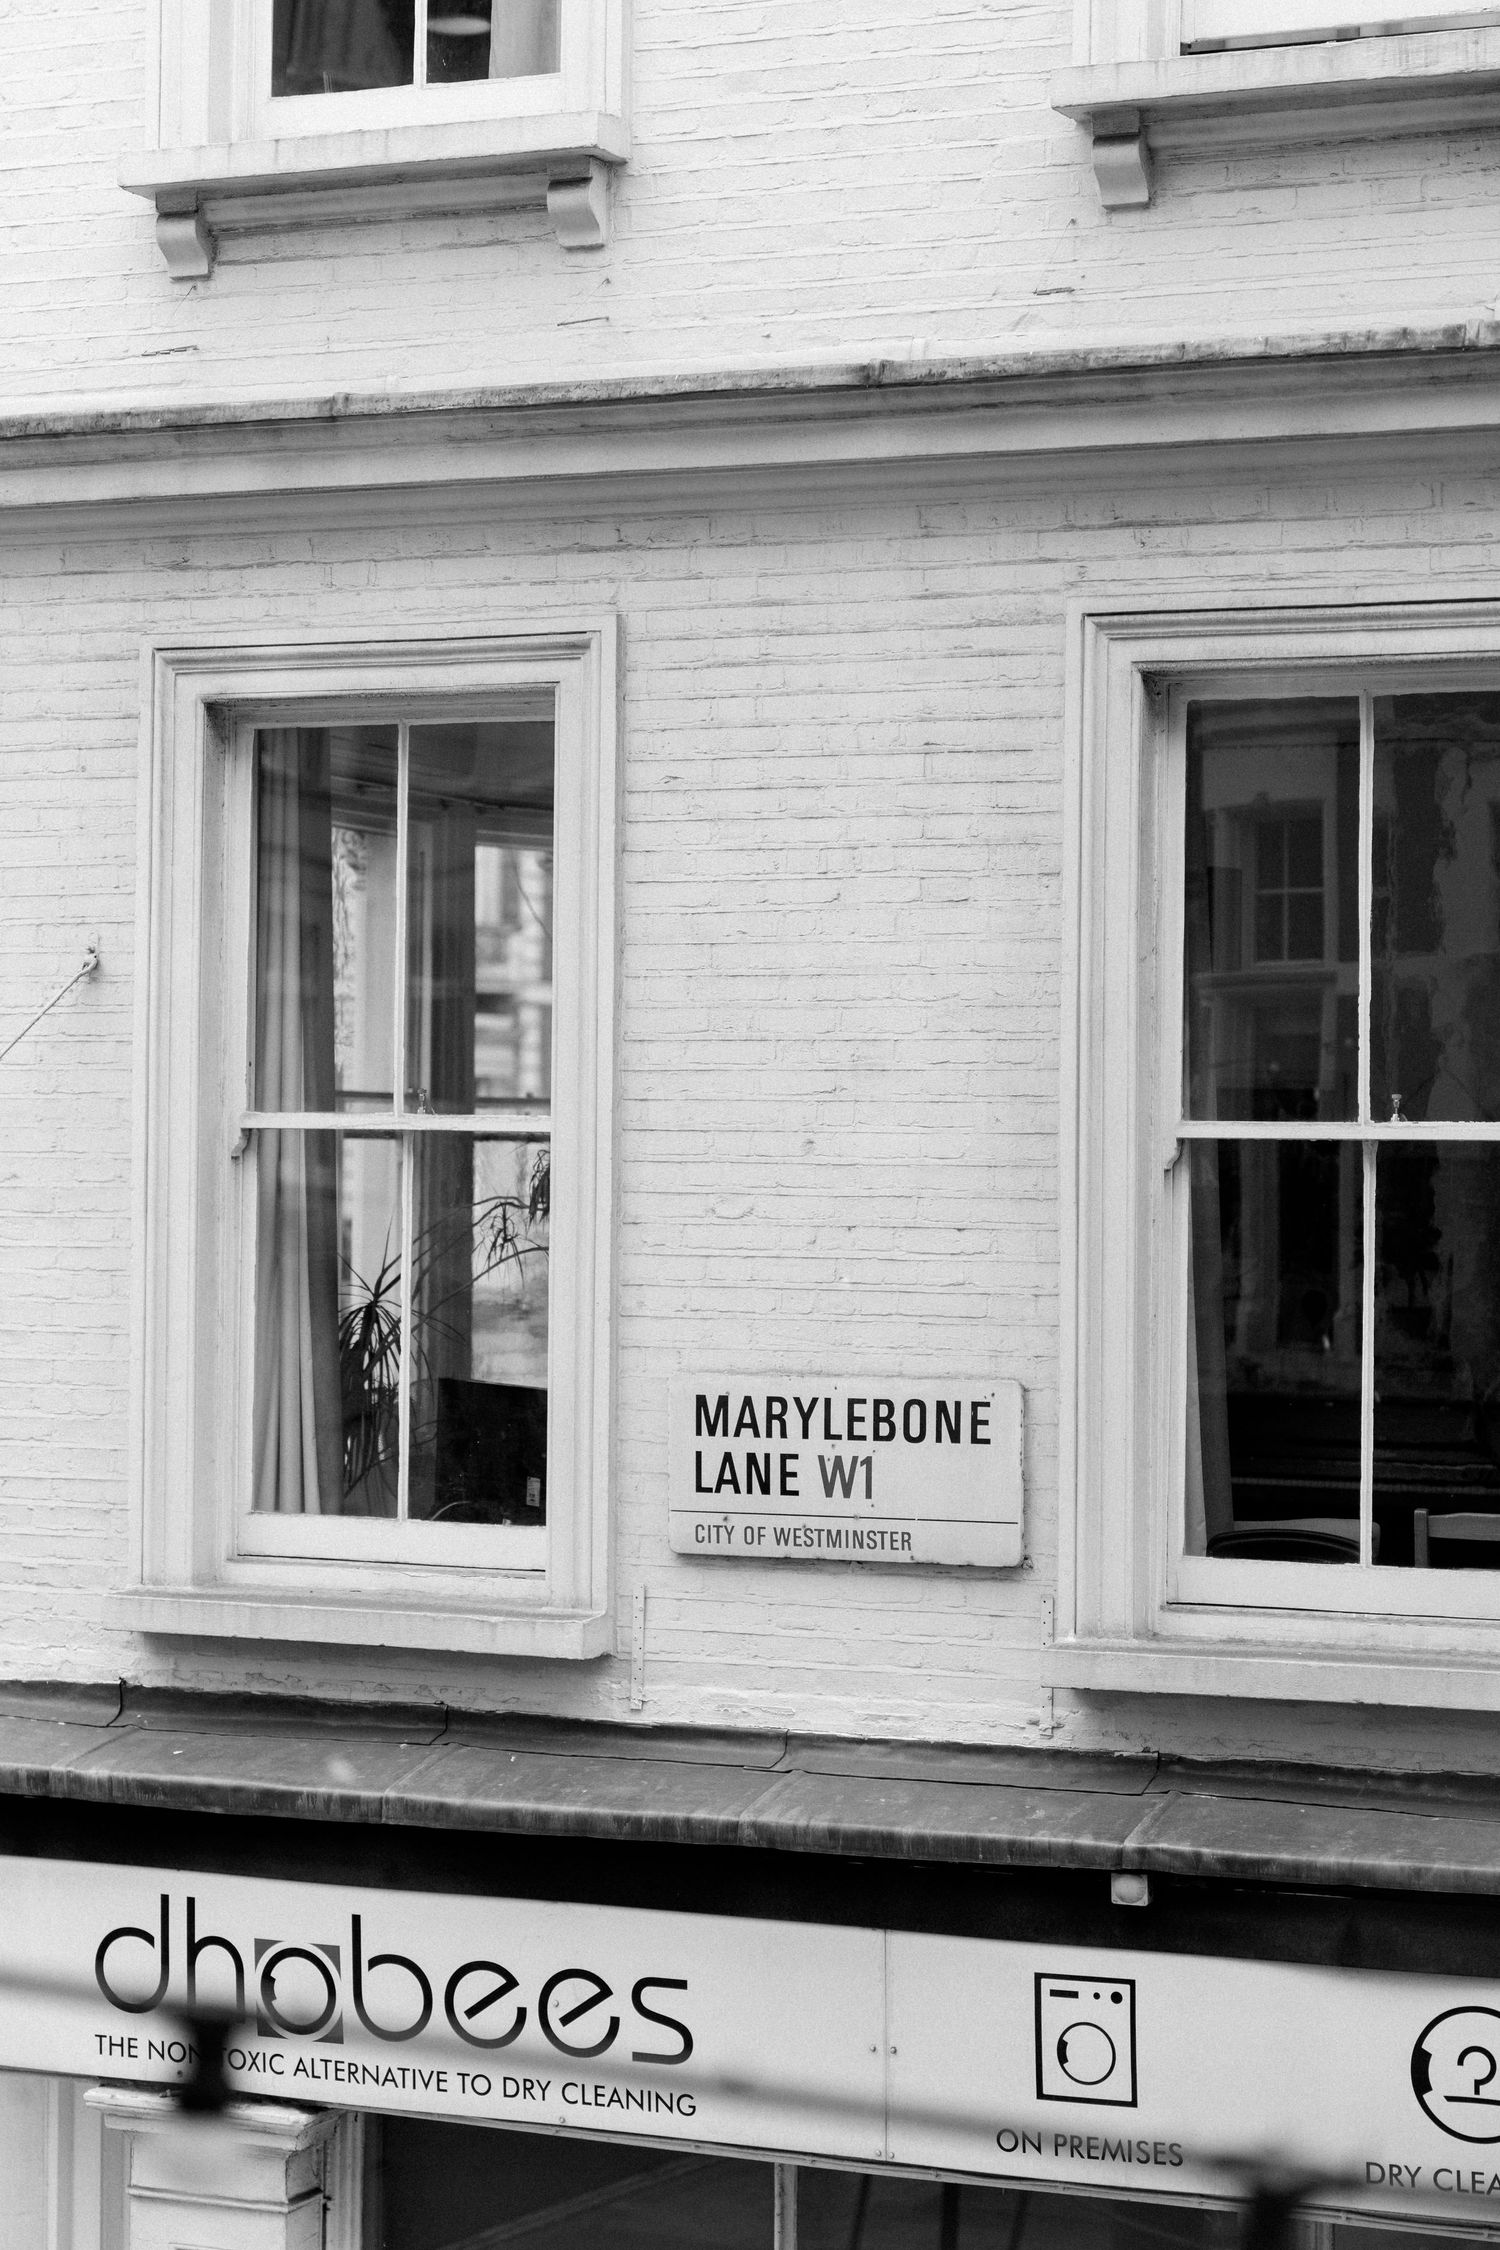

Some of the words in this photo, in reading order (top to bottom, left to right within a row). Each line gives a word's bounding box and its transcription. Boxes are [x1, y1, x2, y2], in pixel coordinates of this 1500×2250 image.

[695, 1394, 991, 1444] MARYLEBONE
[695, 1450, 799, 1496] LANE
[817, 1455, 873, 1500] W1
[695, 1524, 735, 1544] CITY
[743, 1526, 766, 1545] OF
[773, 1528, 912, 1551] WESTMINSTER
[95, 1893, 693, 2065] dhobees
[95, 2034, 138, 2058] THE
[222, 2046, 284, 2075] OXIC
[293, 2057, 448, 2093] ALTERNATIVE
[457, 2073, 491, 2096] TO
[502, 2077, 552, 2101] DRY
[561, 2083, 697, 2117] CLEANING
[996, 2128, 1042, 2155] ON
[1054, 2133, 1184, 2167] PREMISES
[1365, 2161, 1422, 2188] DRY
